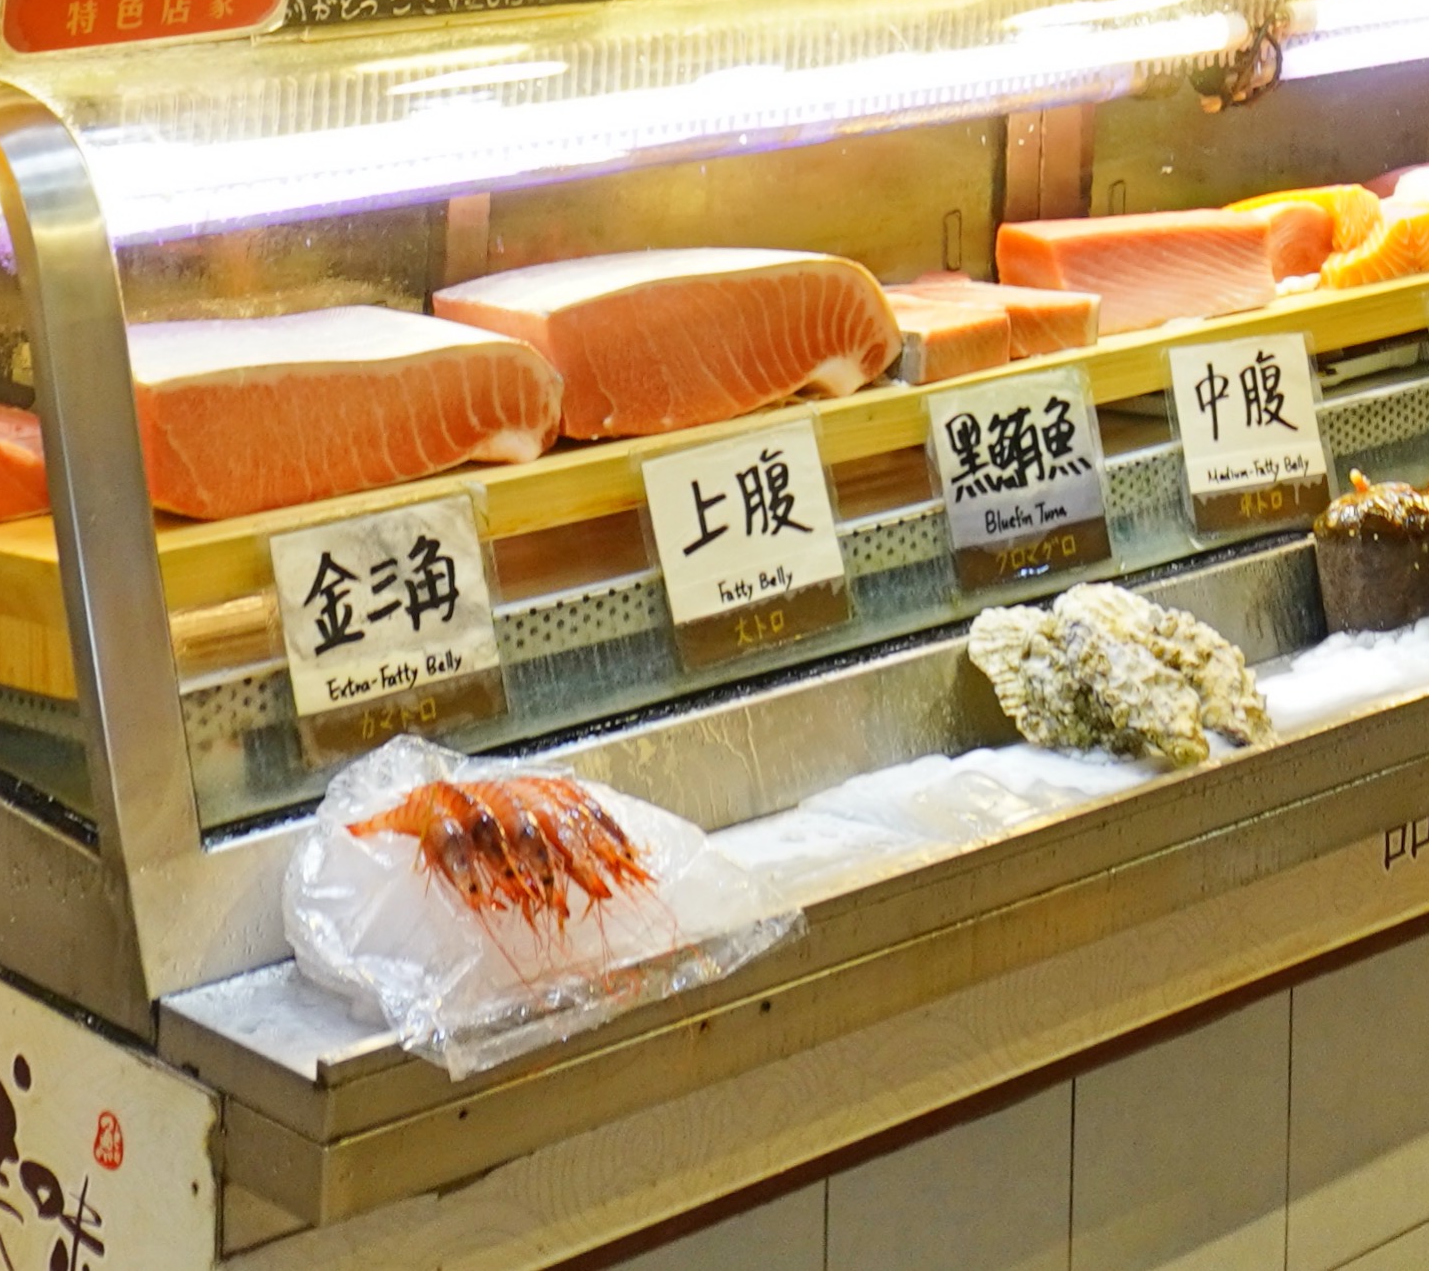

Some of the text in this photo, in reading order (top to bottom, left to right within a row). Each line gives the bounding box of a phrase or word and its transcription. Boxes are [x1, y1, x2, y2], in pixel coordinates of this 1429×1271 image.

[1194, 349, 1300, 443] 中腹
[682, 447, 815, 557] 上腹
[983, 500, 1069, 536] Bluefin Tuna
[303, 534, 460, 656] 金三角
[717, 565, 794, 605] Fatty Belly
